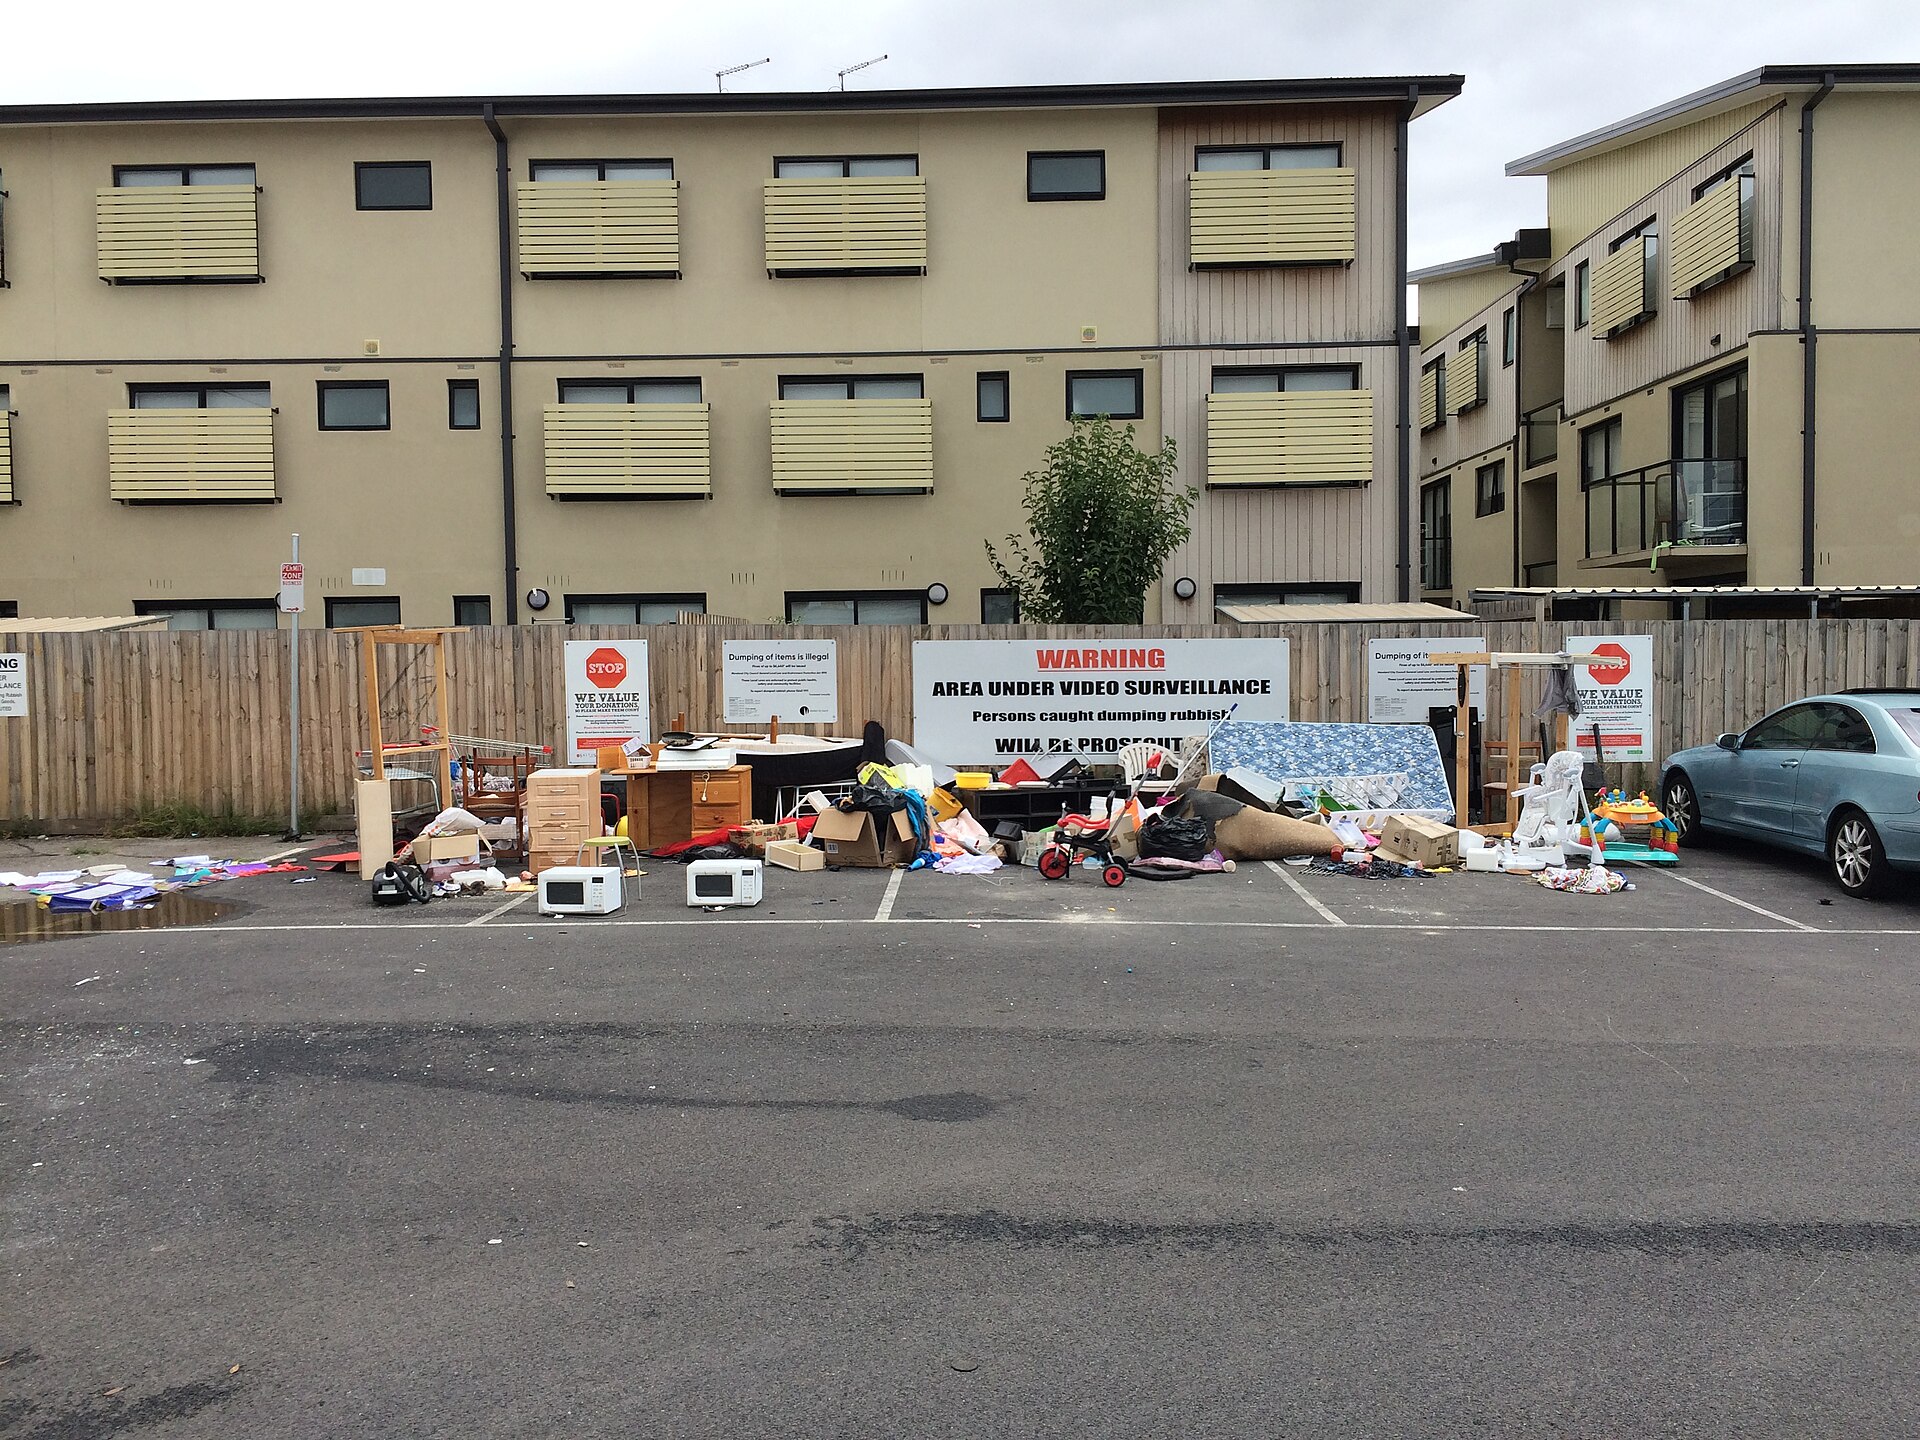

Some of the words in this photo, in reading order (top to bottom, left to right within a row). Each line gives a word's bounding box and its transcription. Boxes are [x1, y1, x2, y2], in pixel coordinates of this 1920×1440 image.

[728, 653, 763, 662] Dumping
[805, 653, 829, 661] illegal
[1036, 649, 1165, 668] WARNING
[1375, 652, 1411, 661] Dumping
[589, 662, 624, 674] STOP
[932, 681, 983, 696] AREA
[989, 681, 1054, 696] UNDER
[1059, 681, 1119, 695] VIDEO
[1125, 680, 1270, 695] SURVEILLANCE
[1577, 690, 1597, 699] WE
[1600, 689, 1643, 698] VALUE
[575, 693, 596, 702] WE
[599, 693, 640, 702] VALUE
[972, 711, 1036, 721] Persons
[1039, 710, 1094, 722] caught
[1097, 709, 1166, 722] dumping
[1170, 710, 1230, 721] rubbish
[1048, 738, 1073, 752] BE
